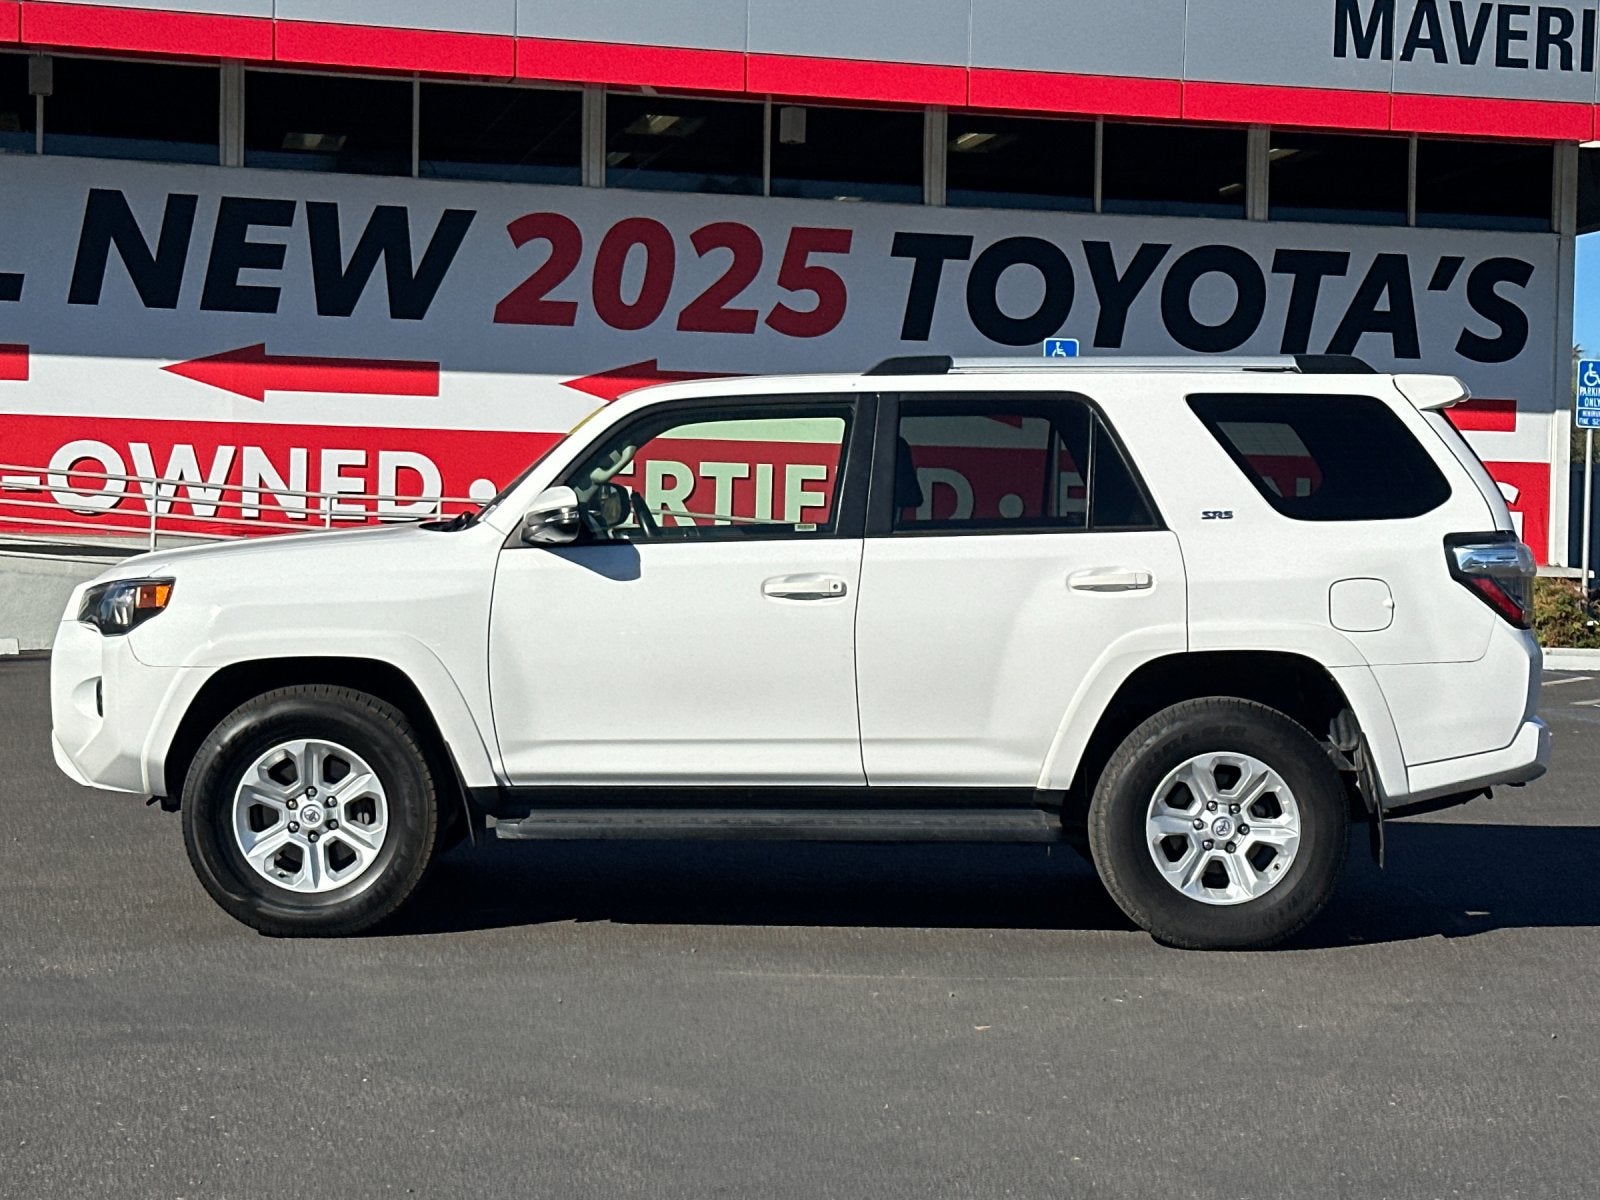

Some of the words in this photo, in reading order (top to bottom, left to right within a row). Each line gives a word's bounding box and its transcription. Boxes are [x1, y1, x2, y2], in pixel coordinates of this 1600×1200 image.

[1333, 0, 1596, 73] MAVERI
[67, 187, 477, 321] NEW
[493, 212, 853, 338] 2025
[891, 231, 1535, 364] TOYOTA'S
